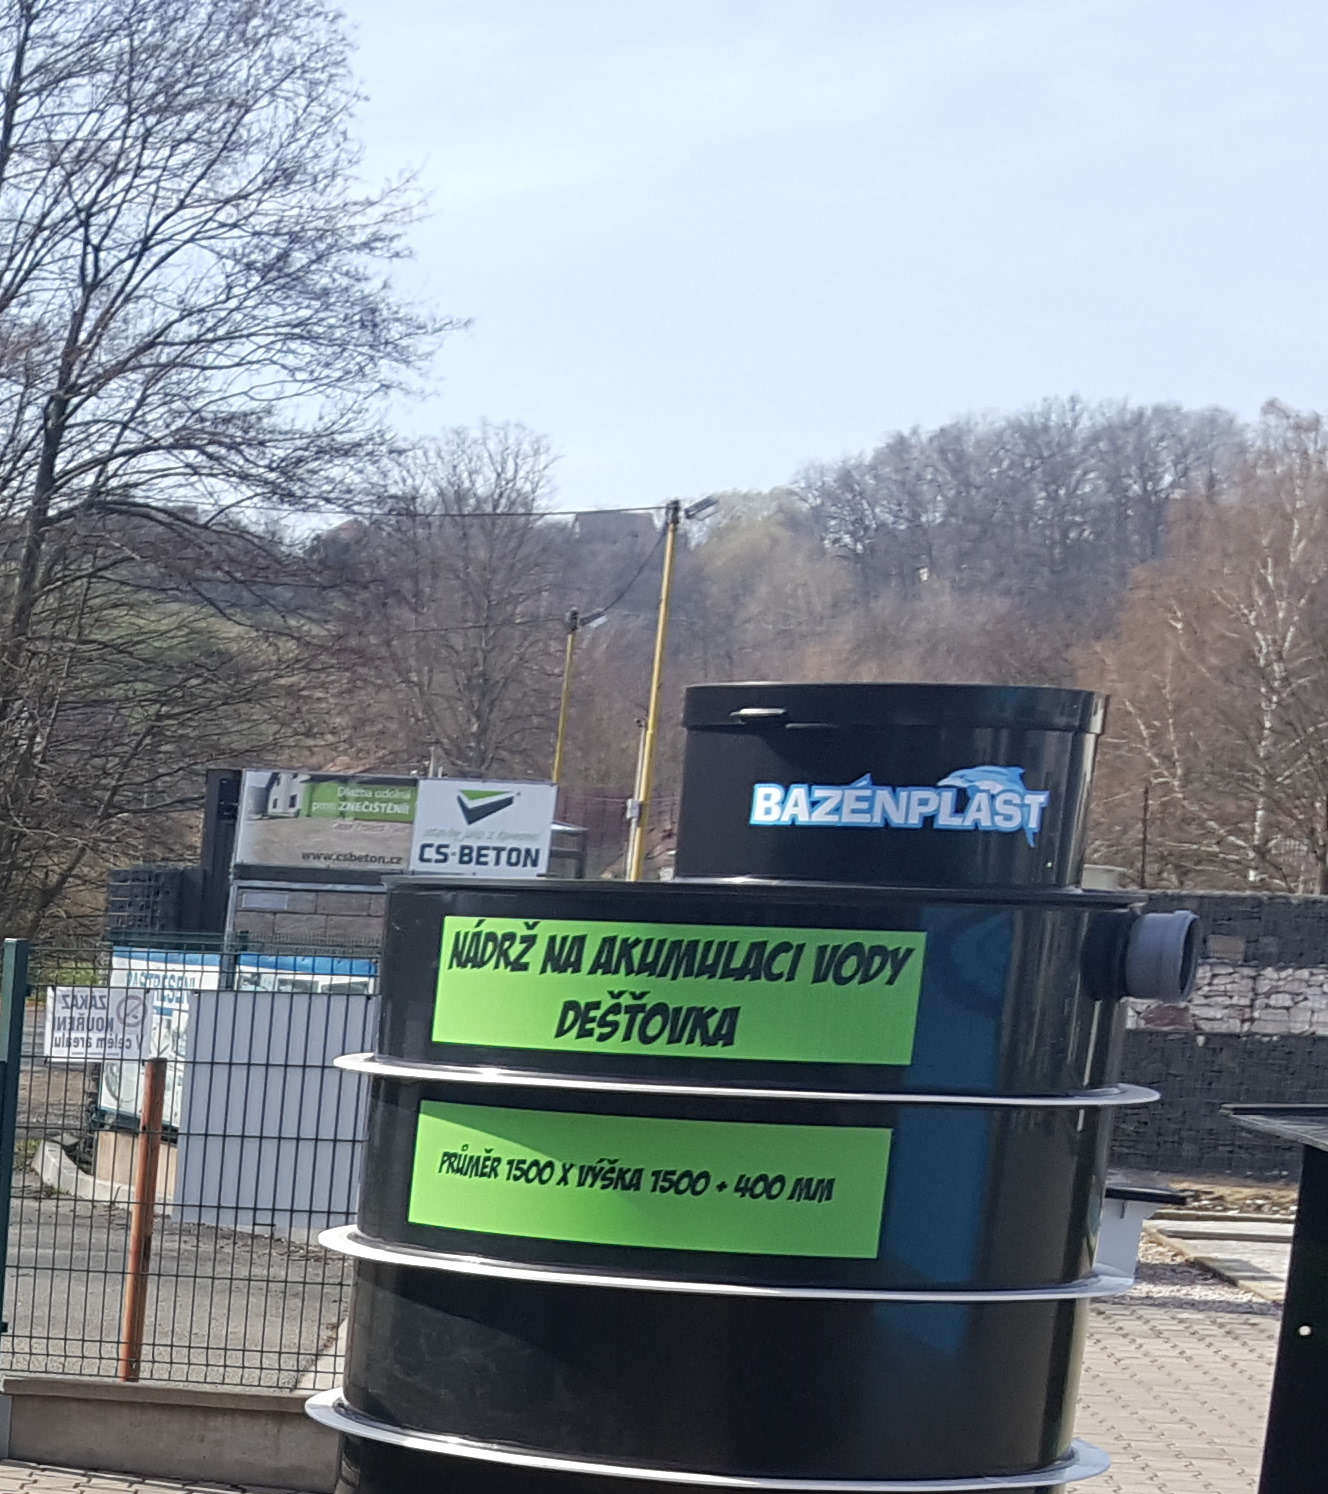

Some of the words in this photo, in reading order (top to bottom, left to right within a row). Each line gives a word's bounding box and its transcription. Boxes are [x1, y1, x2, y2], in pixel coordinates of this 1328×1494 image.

[749, 772, 1049, 832] BAZÉNPLAST
[301, 850, 404, 866] www.csbeton.cz
[448, 919, 539, 972] NÁDRŽ
[540, 934, 586, 976] NA
[589, 934, 806, 983] AKUMULACI
[811, 940, 914, 986] VODY
[554, 990, 741, 1048] DEŠŤOVKA
[438, 1143, 501, 1181] PRŮMĚR
[505, 1159, 555, 1185] 1500
[556, 1162, 573, 1187] X
[576, 1157, 643, 1193] VÝŠKA
[650, 1170, 711, 1196] 1500
[734, 1173, 786, 1200] 400
[788, 1176, 837, 1204] MM
